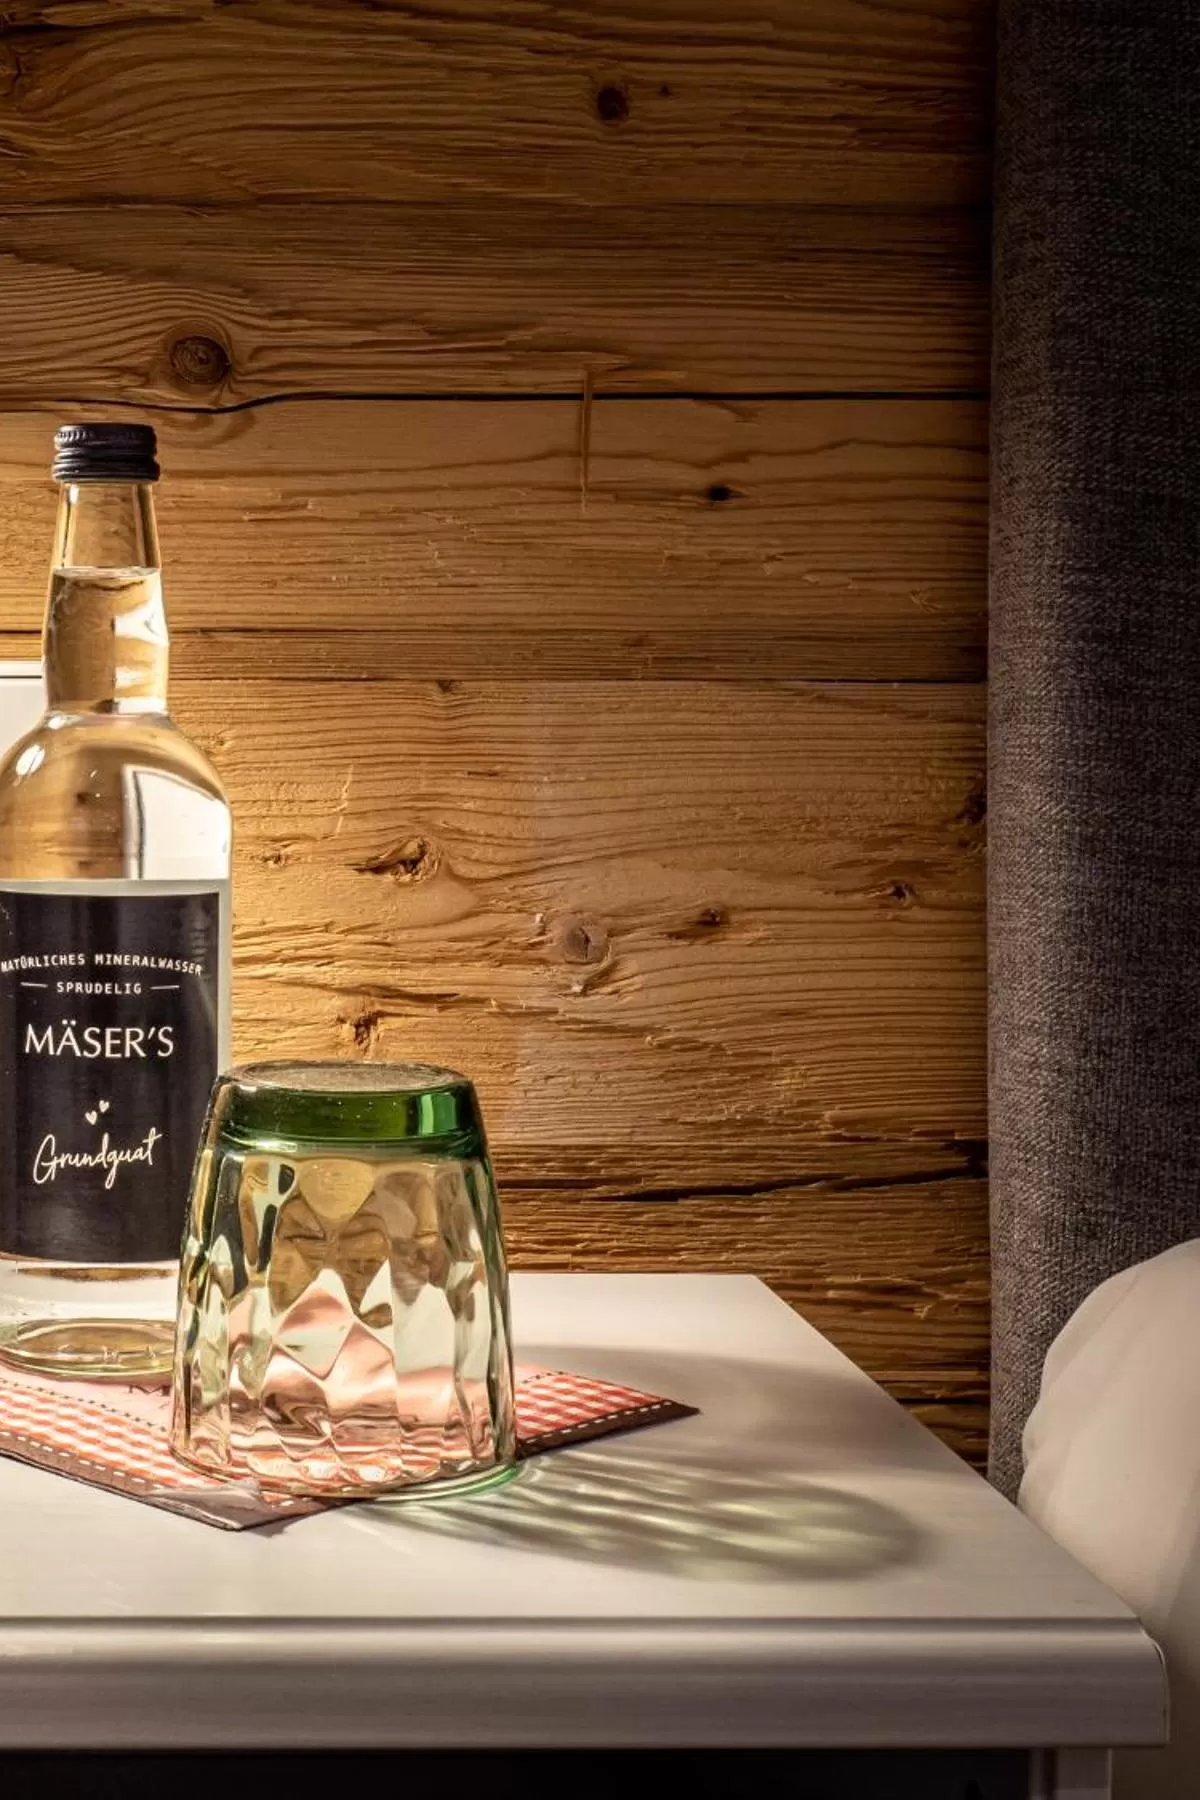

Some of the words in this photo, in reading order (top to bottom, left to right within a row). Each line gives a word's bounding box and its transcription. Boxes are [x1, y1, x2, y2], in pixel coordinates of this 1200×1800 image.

[0, 953, 86, 972] NATÜRLICHES
[94, 953, 202, 976] MINERALWASSER
[56, 981, 142, 994] SPRUDELIG
[25, 1019, 174, 1058] MÄSER'S
[32, 1127, 162, 1189] Grundguat
